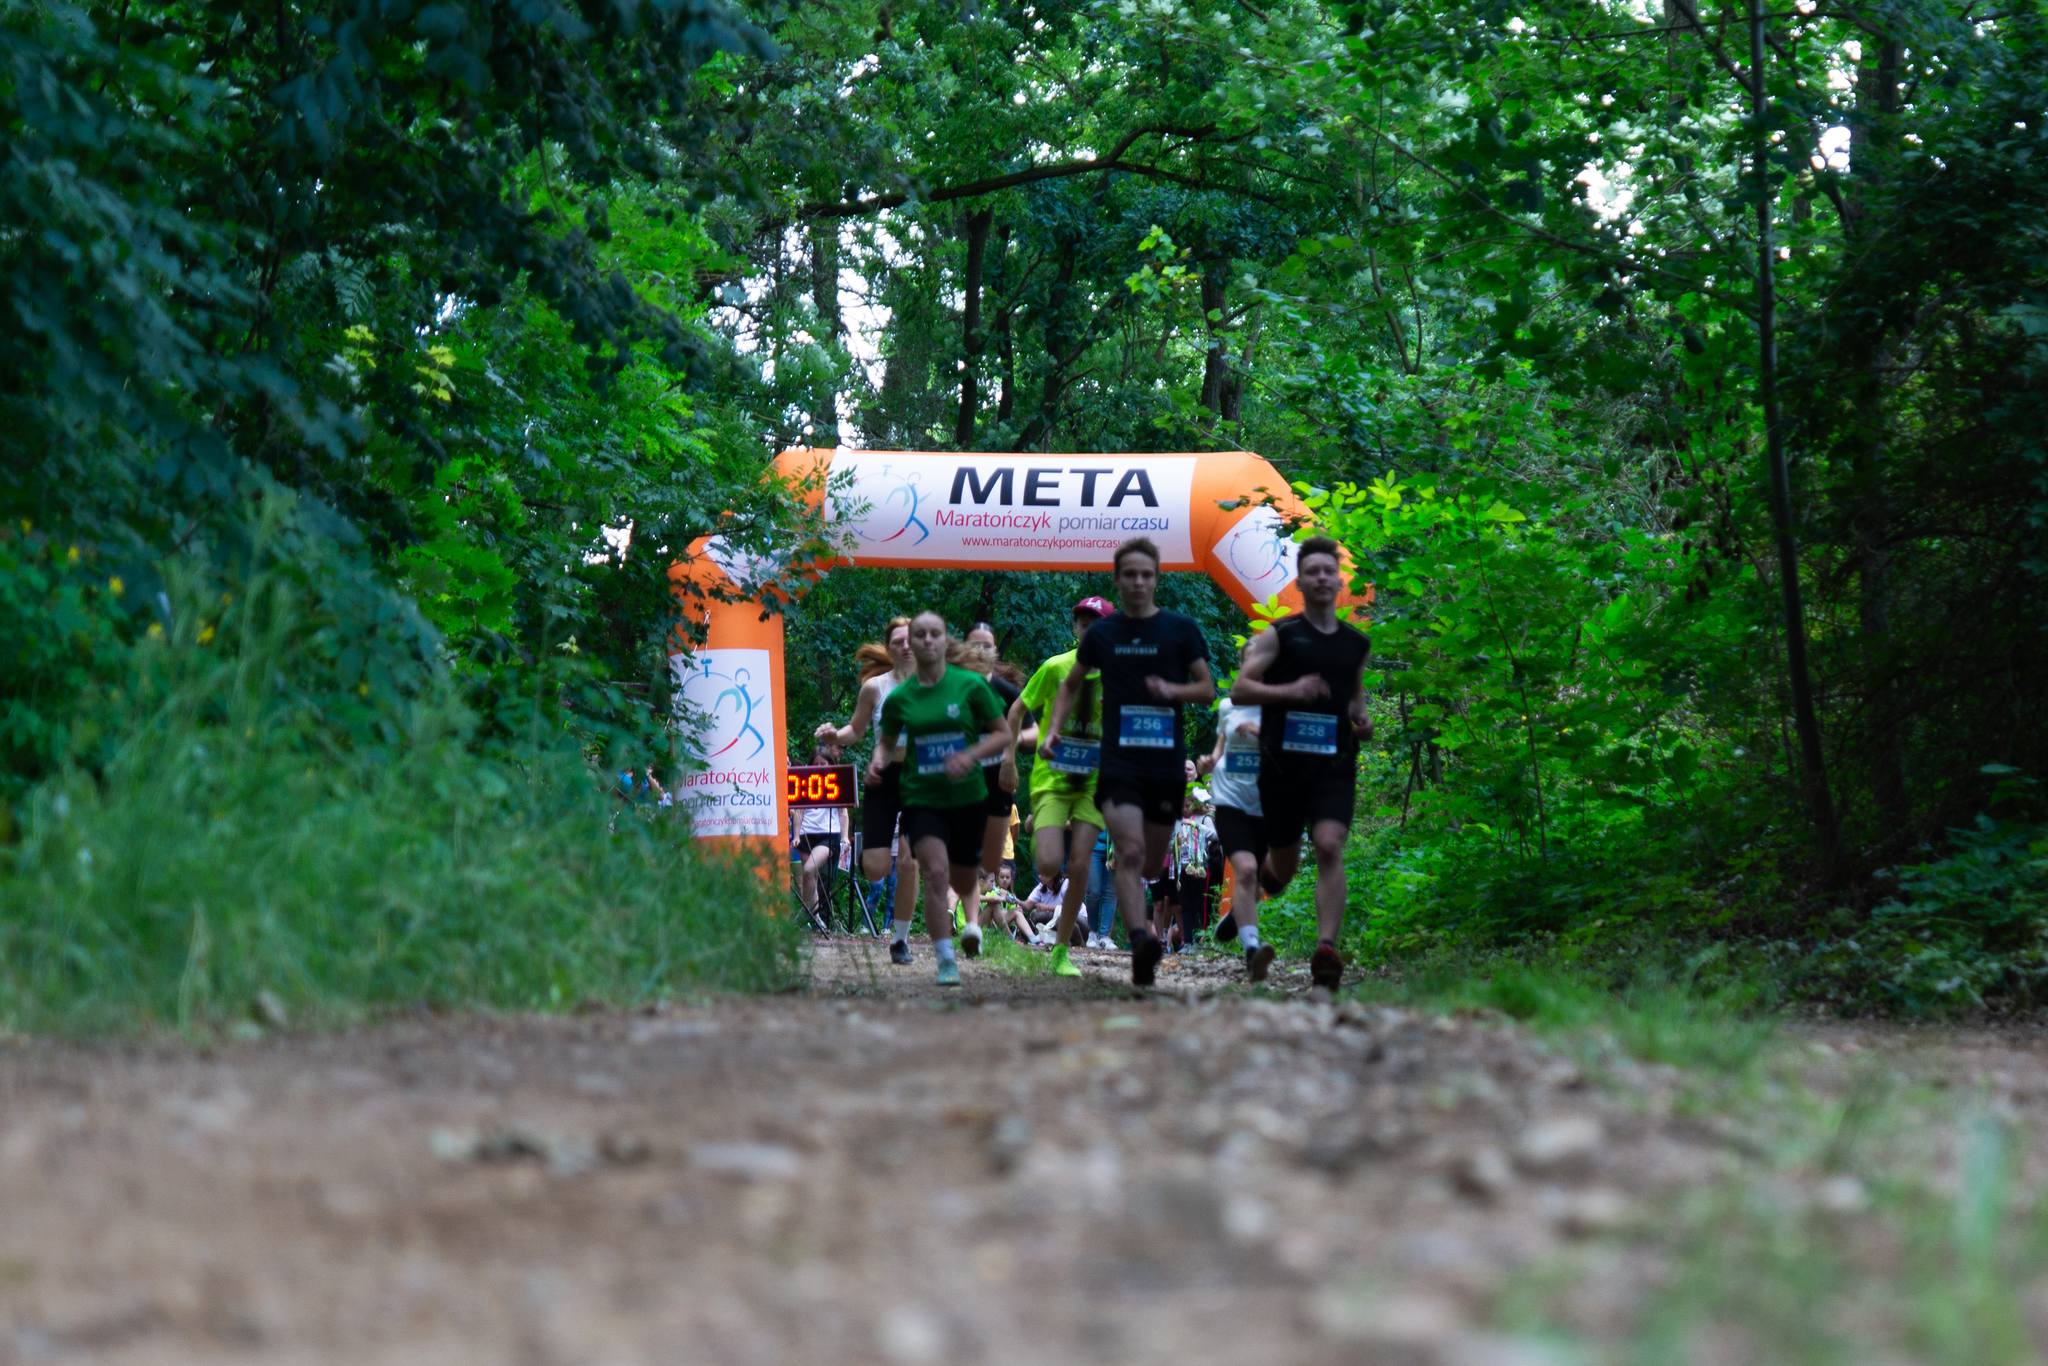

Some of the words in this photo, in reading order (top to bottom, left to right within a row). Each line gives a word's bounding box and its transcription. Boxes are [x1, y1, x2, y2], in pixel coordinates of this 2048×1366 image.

[949, 467, 1160, 508] META
[935, 510, 1052, 532] Maratończyk
[962, 536, 1121, 550] www.maratonczykpomiarczas
[1133, 718, 1162, 731] 256
[1297, 723, 1326, 737] 258
[1063, 746, 1089, 759] 257
